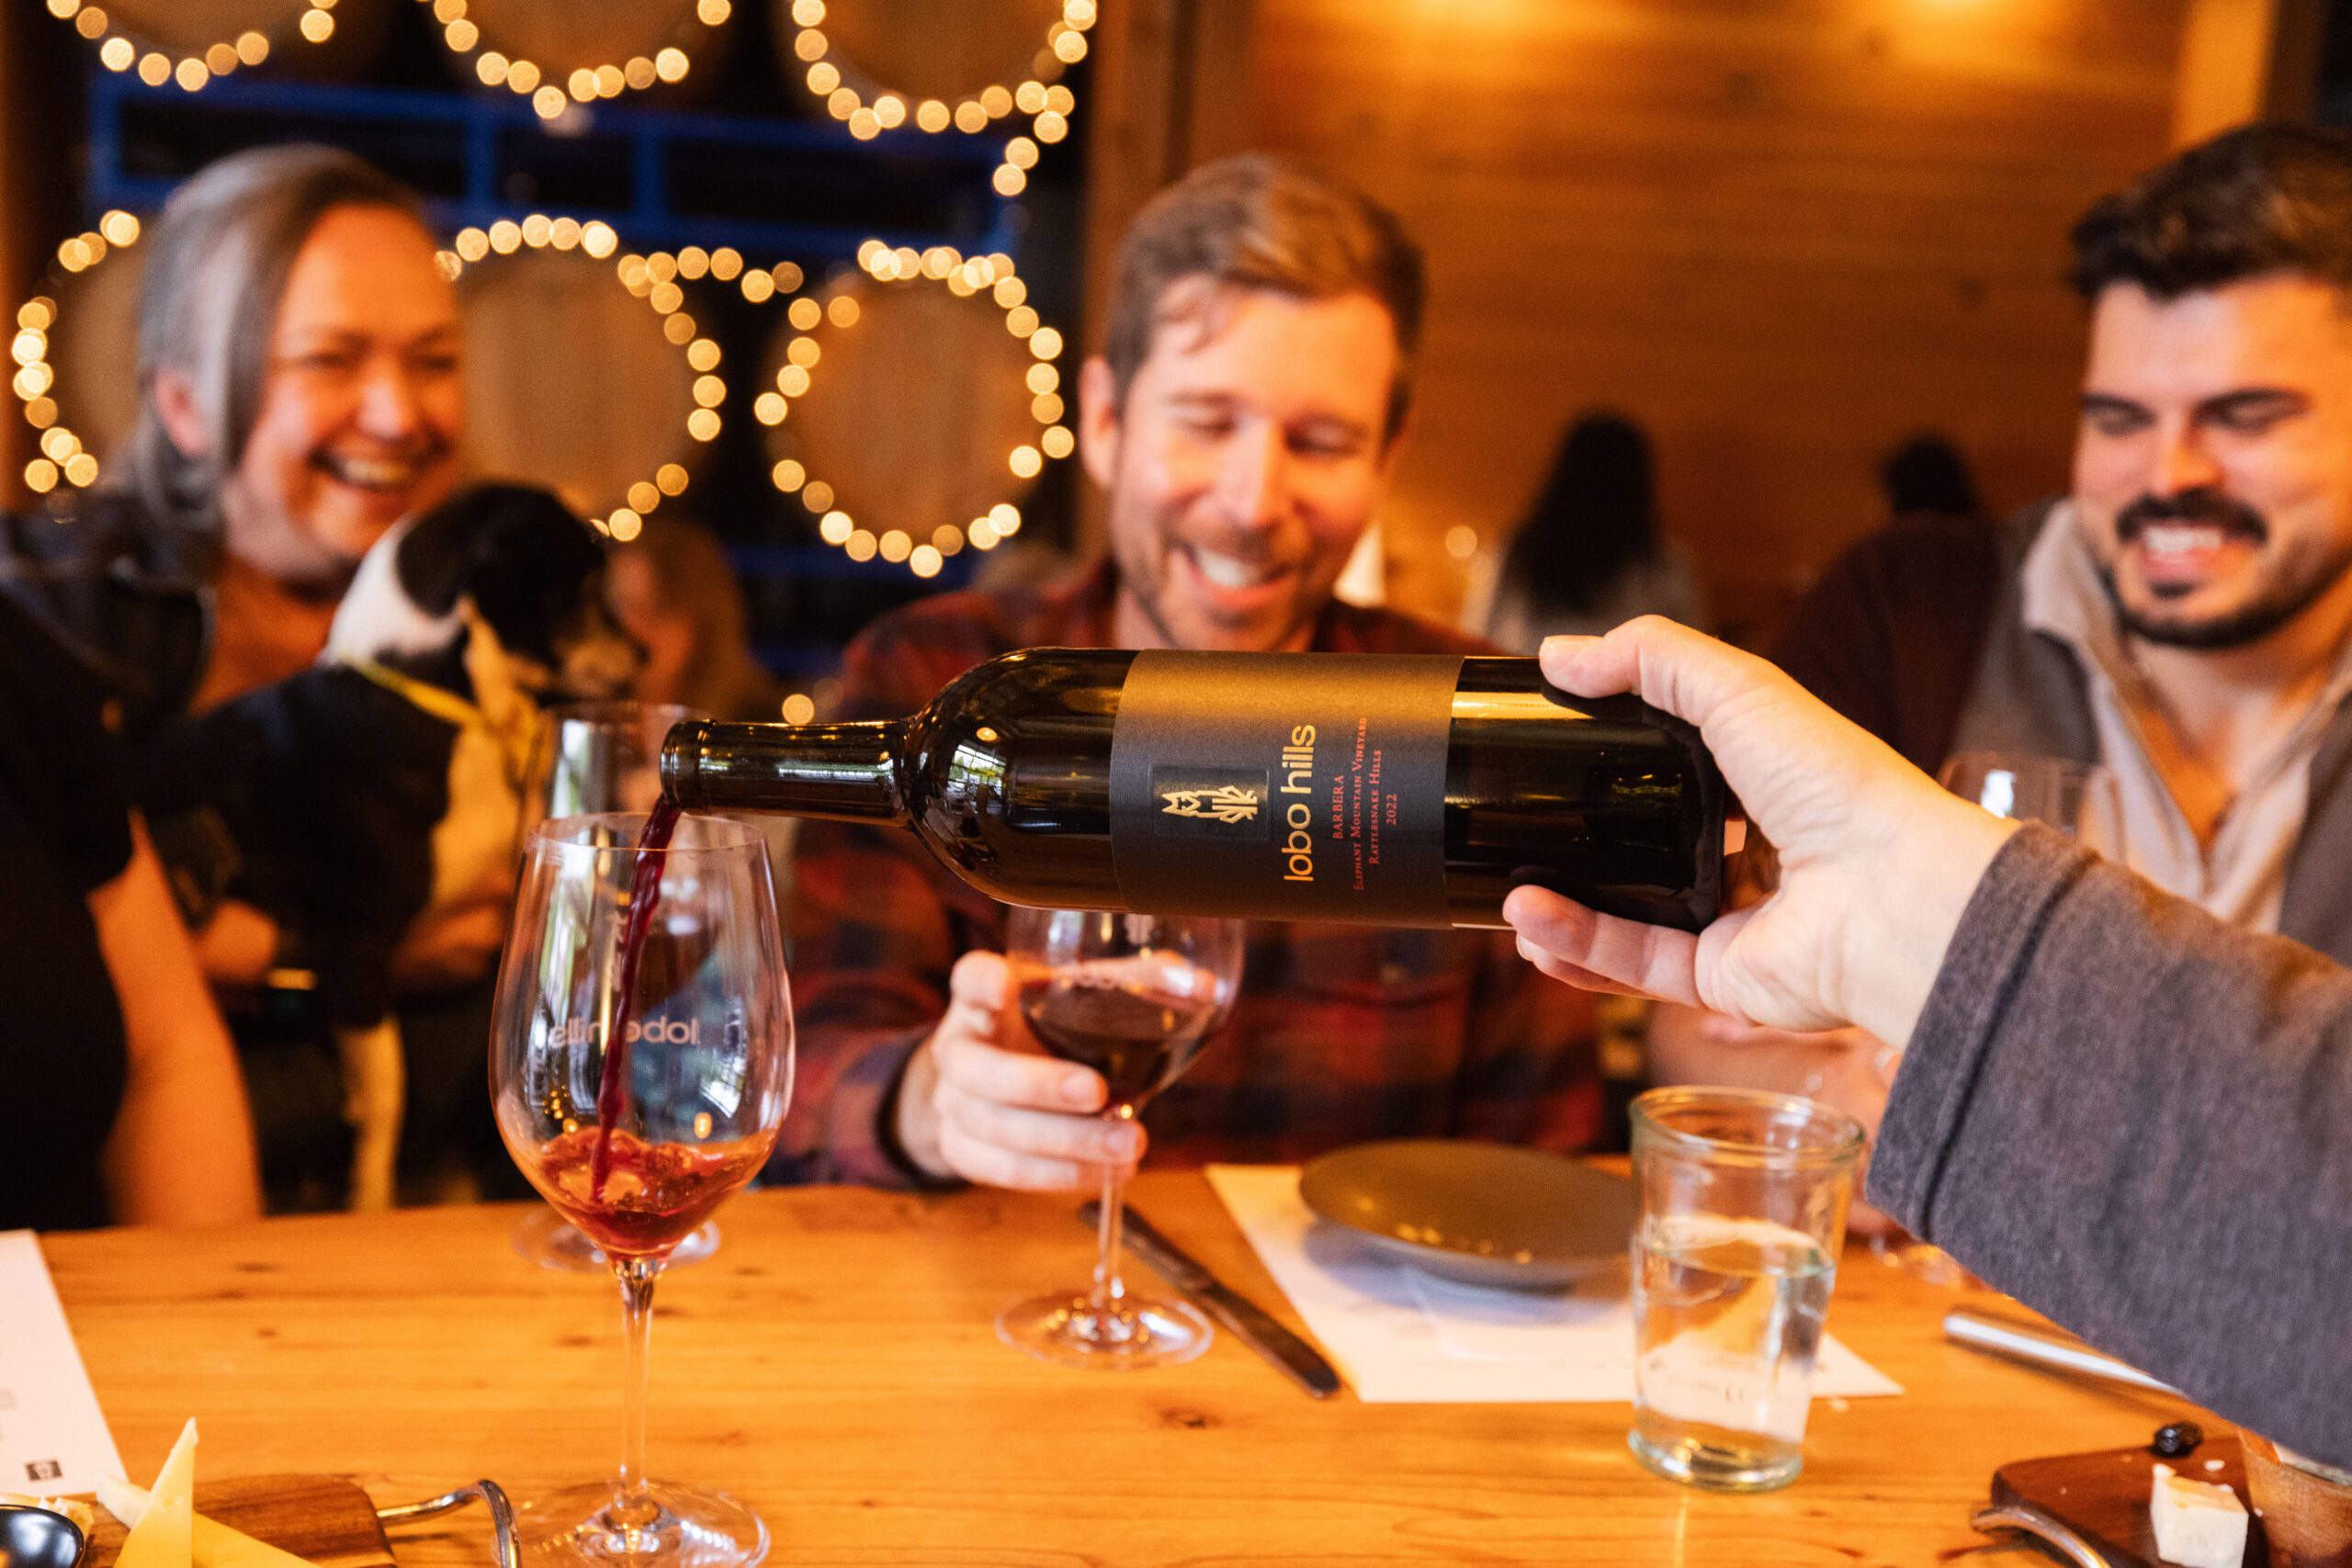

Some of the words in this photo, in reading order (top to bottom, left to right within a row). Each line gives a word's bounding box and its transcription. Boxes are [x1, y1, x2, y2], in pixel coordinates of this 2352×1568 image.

[1280, 724, 1317, 795] hills
[1351, 716, 1367, 773] VINEYARD
[1368, 750, 1382, 784] HILLS
[1331, 774, 1344, 840] BARBERA
[1350, 774, 1362, 839] MOUNTAIN
[1368, 789, 1380, 865] RATTLESNAKE
[1385, 794, 1397, 826] 2022
[1281, 803, 1314, 881] lobo
[1352, 842, 1364, 891] ELEPHANT
